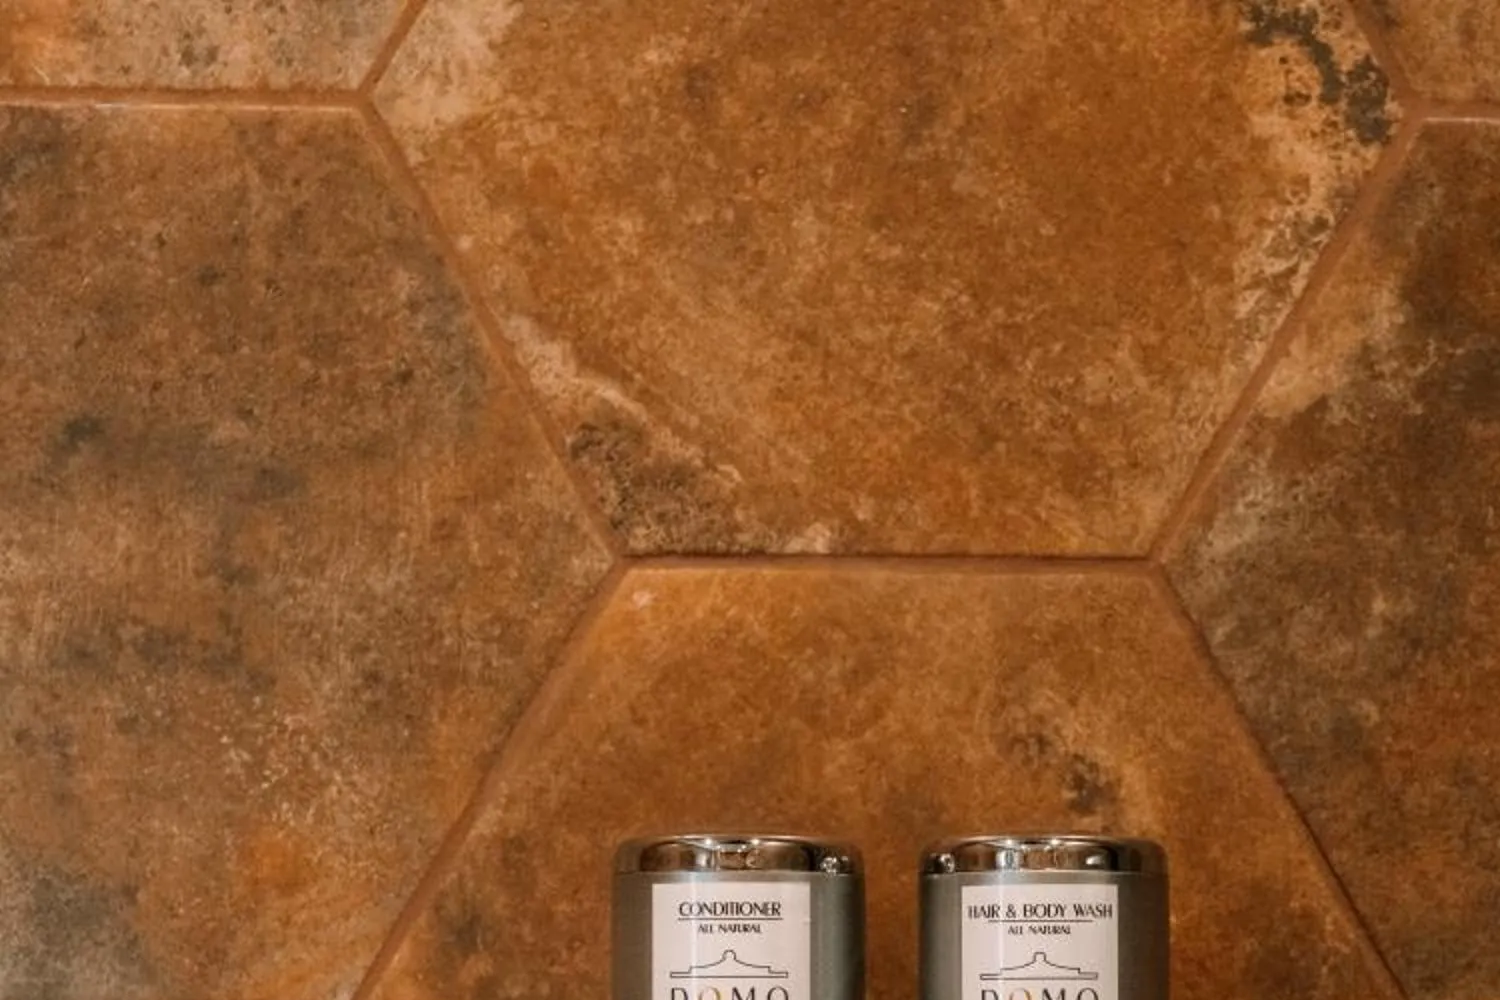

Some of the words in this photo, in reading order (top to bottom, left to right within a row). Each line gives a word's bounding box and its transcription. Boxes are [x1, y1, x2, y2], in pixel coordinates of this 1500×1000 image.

[678, 901, 782, 917] CONDITIONER
[967, 904, 1001, 919] HAIR
[1005, 903, 1018, 919] &
[1023, 903, 1068, 919] BODY
[1073, 903, 1113, 919] WASH
[697, 923, 714, 934] ALL
[718, 923, 762, 934] NATURAL
[1007, 926, 1024, 936] ALL
[1028, 926, 1072, 936] NATURAL
